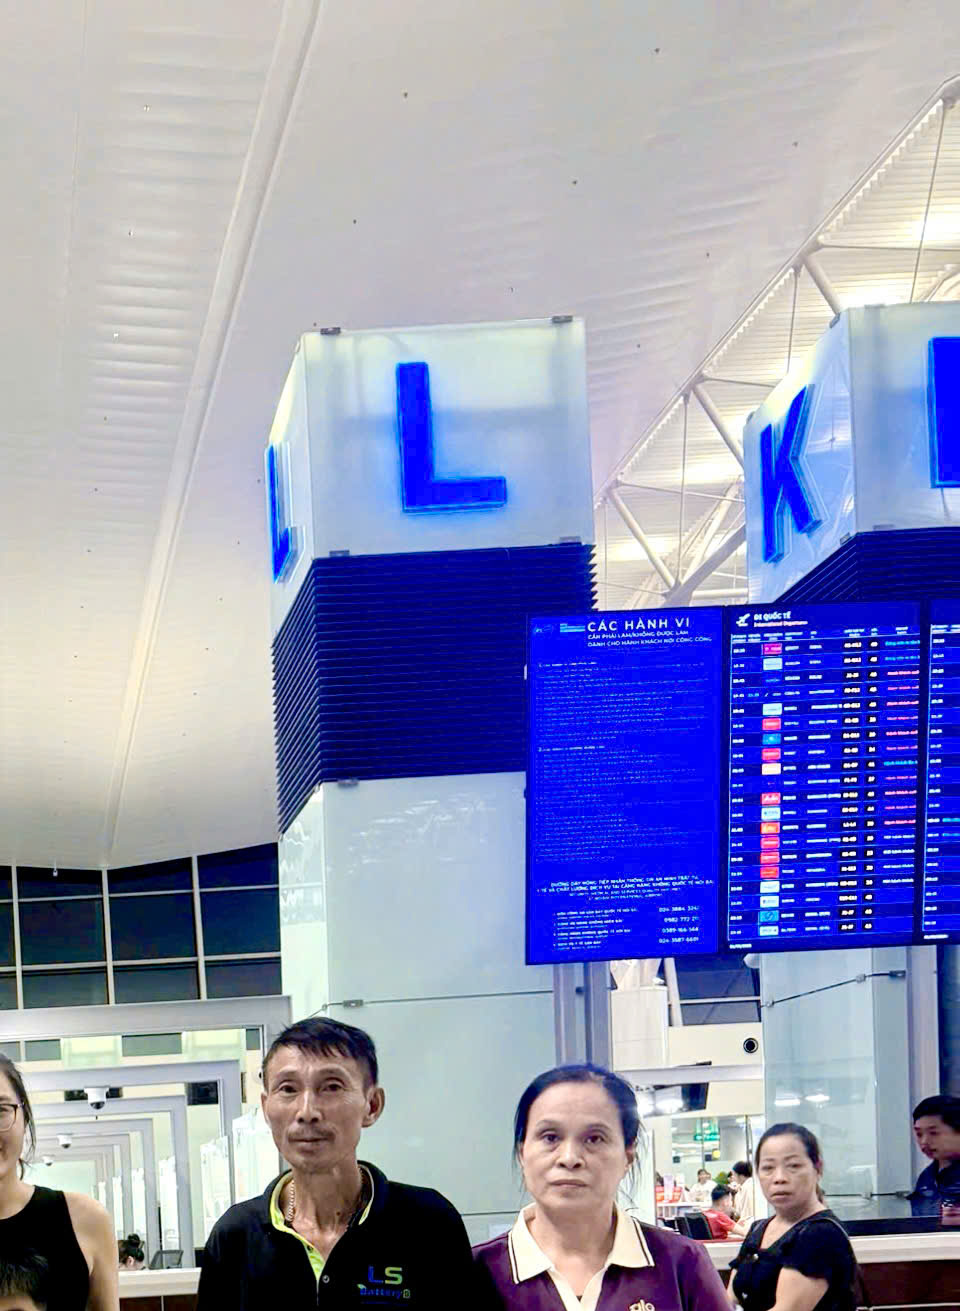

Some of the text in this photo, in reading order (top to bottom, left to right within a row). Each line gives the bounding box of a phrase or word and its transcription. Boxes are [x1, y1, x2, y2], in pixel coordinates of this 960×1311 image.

[395, 361, 507, 514] L
[759, 383, 823, 564] K
[587, 619, 618, 632] CÁC
[624, 617, 668, 631] HÀNH
[675, 617, 690, 628] VI
[367, 1265, 403, 1285] LS
